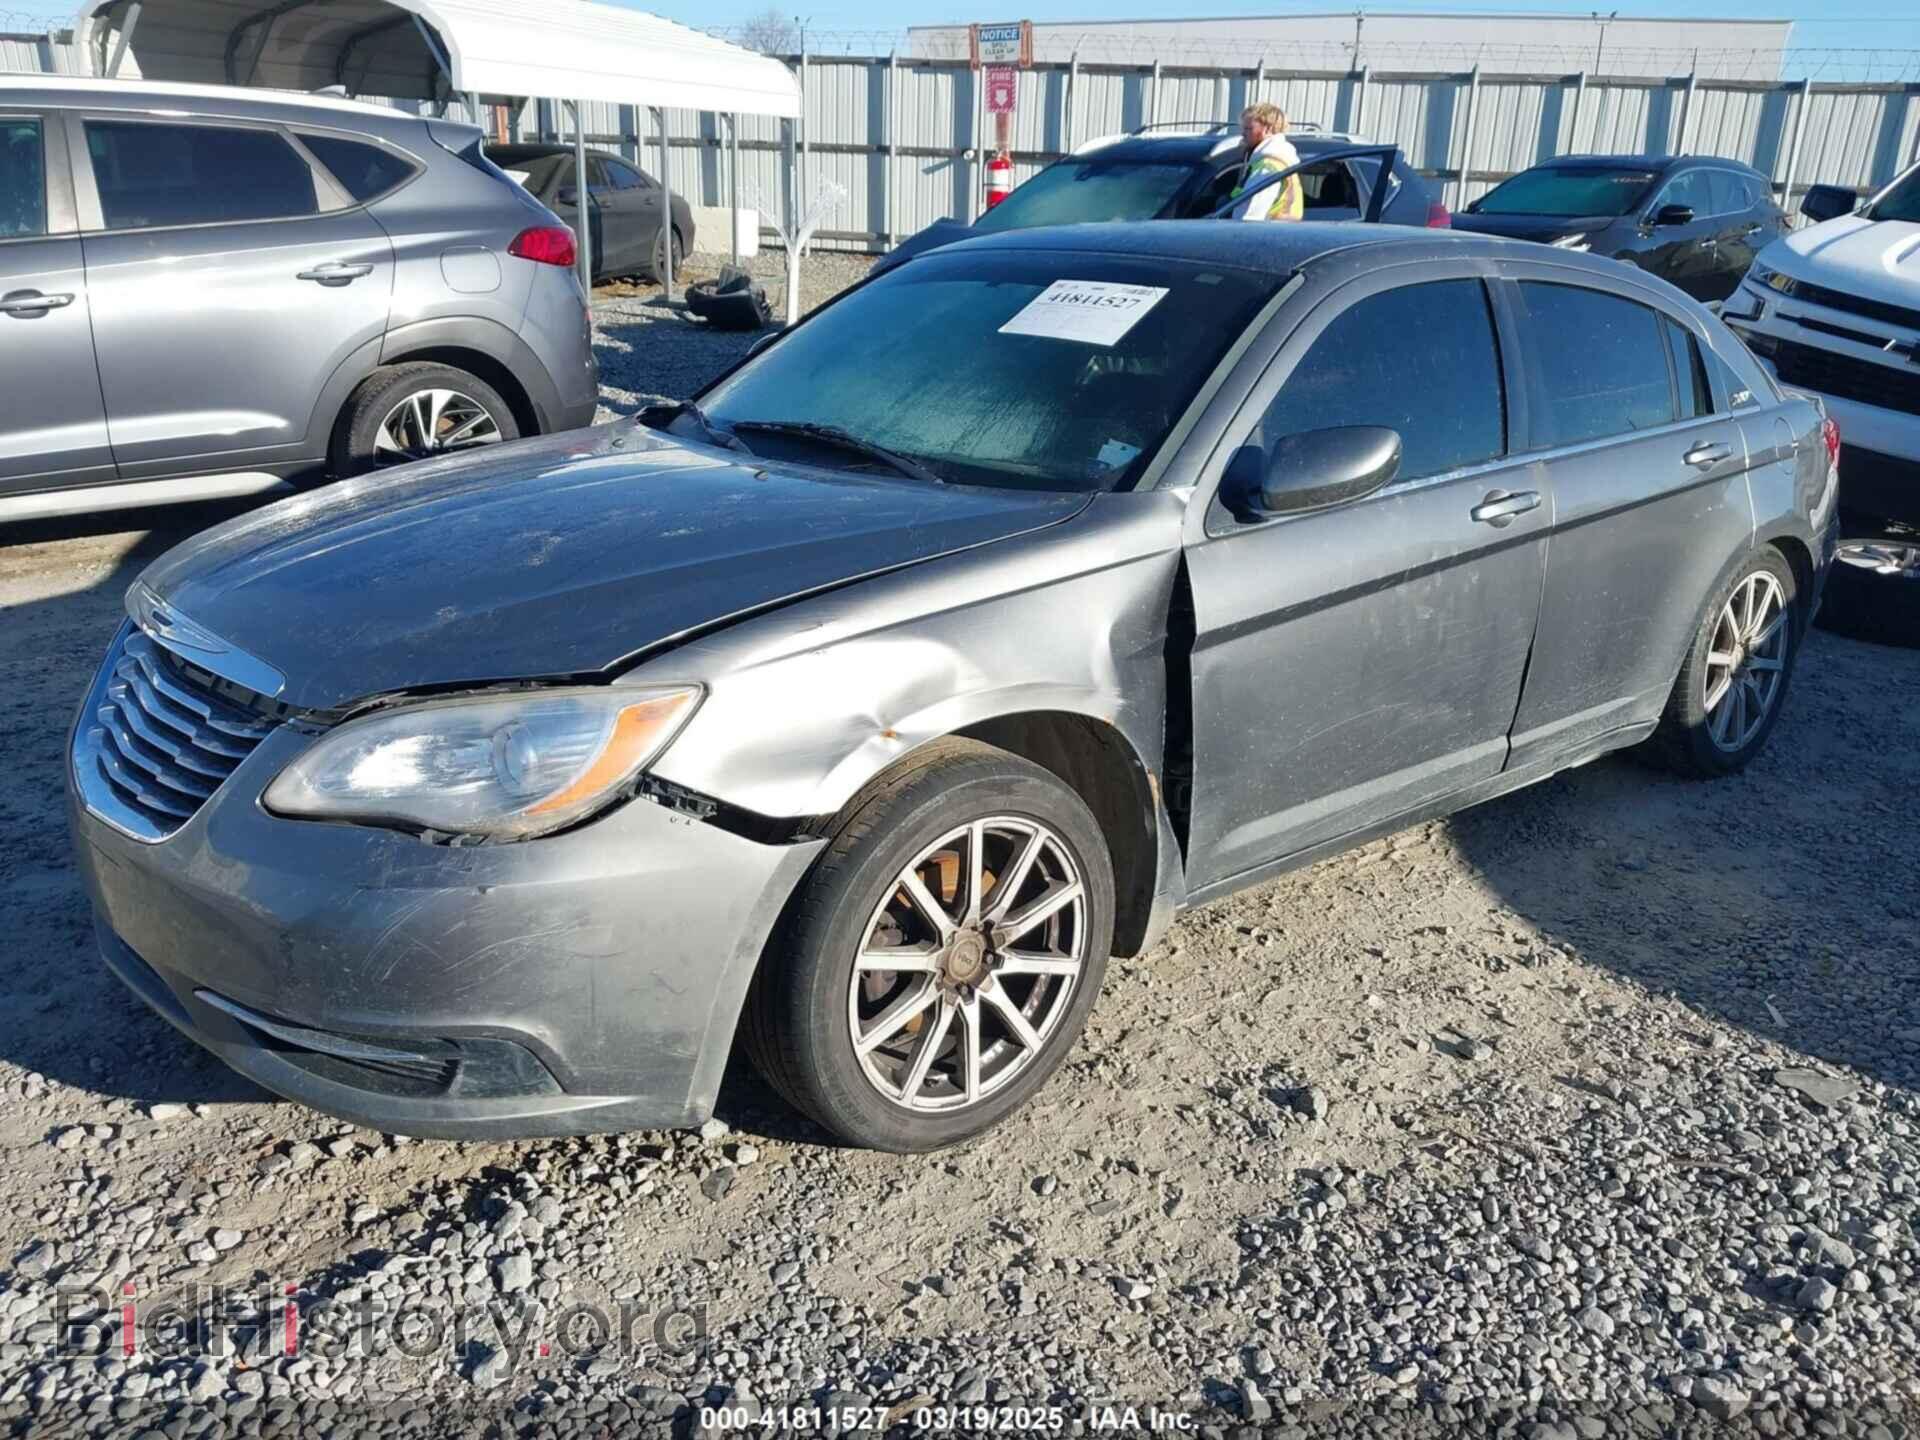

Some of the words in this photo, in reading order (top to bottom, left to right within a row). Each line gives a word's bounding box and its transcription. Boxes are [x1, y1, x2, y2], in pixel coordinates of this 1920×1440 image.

[981, 29, 1017, 41] NOTICE
[991, 72, 1011, 81] FIRE
[1048, 291, 1141, 309] 41811527
